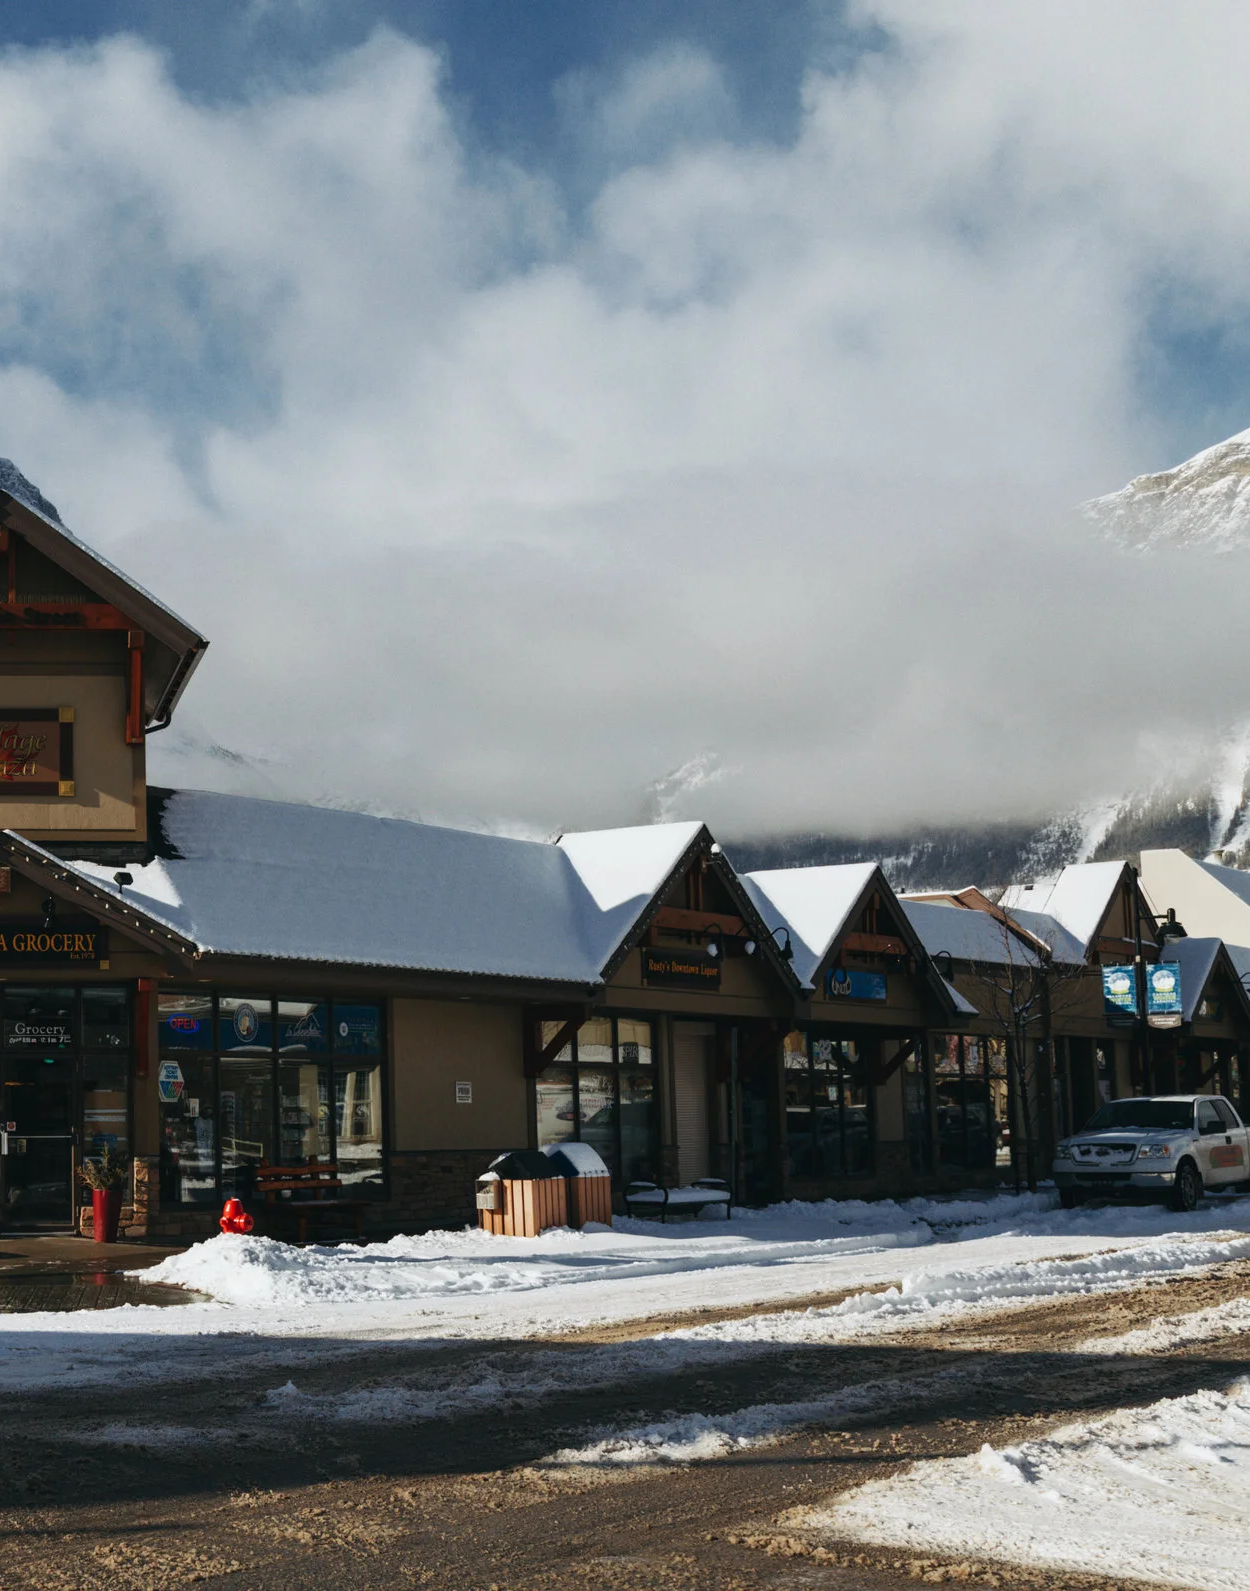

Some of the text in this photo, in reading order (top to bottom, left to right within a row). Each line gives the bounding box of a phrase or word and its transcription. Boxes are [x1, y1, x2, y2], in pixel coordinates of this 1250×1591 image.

[24, 607, 87, 626] Street
[12, 934, 96, 952] GROCERY
[14, 1022, 66, 1037] Grocery
[170, 1018, 197, 1029] OPEN
